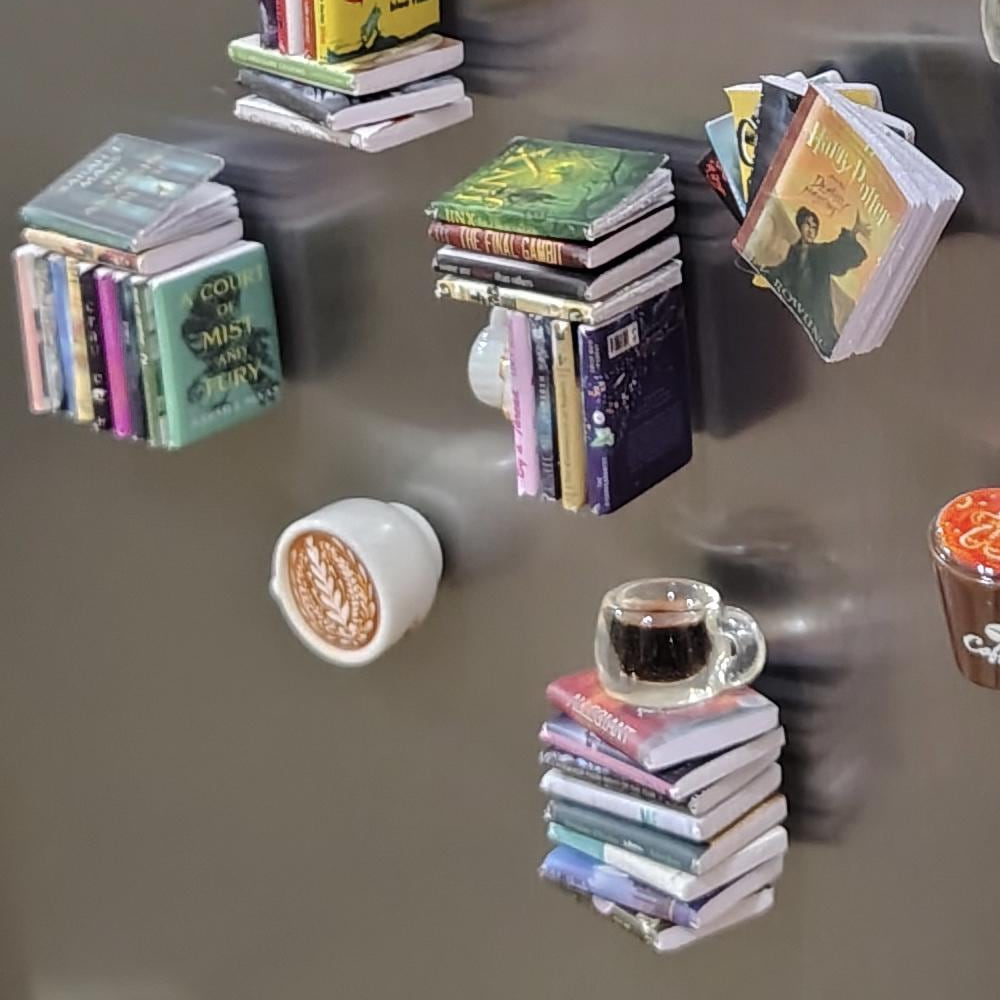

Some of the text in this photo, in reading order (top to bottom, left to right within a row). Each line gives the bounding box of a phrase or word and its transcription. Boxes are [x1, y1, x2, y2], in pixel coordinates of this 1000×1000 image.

[460, 229, 481, 251] THE
[484, 230, 520, 258] FINAL
[521, 237, 565, 266] GAMBIT
[200, 264, 264, 301] COURT
[200, 317, 252, 350] MIST
[217, 346, 248, 366] AND
[202, 359, 263, 397] FURY
